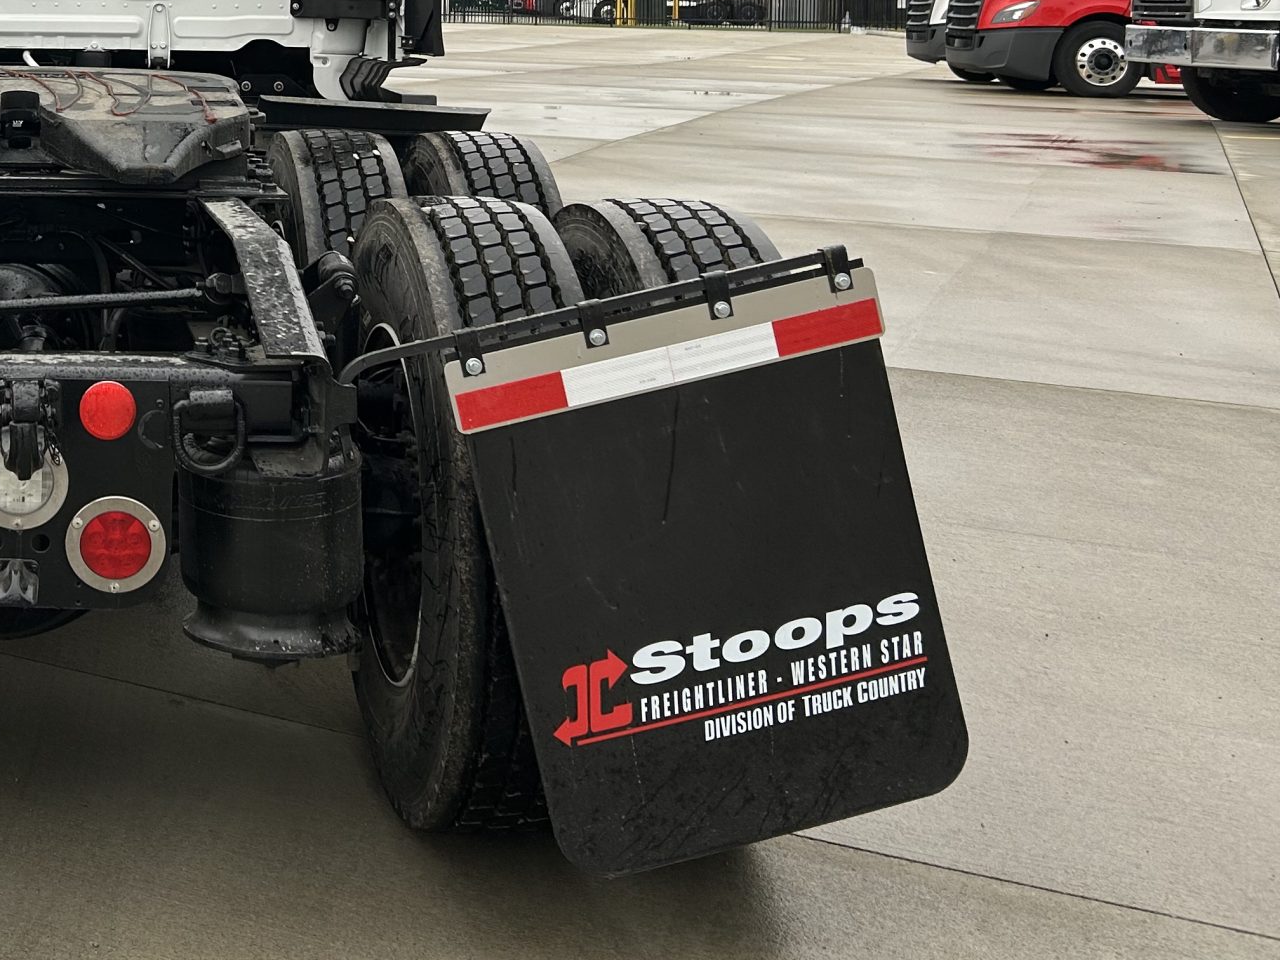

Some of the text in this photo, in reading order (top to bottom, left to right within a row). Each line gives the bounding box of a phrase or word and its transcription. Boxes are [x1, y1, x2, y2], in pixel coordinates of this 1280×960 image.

[629, 592, 920, 685] Stoops
[640, 669, 768, 723] FREIGHTLINER
[790, 643, 872, 686] WESTERN
[880, 630, 923, 664] STAR
[704, 667, 926, 742] DIVISION OF TRUCK COUNTRY
